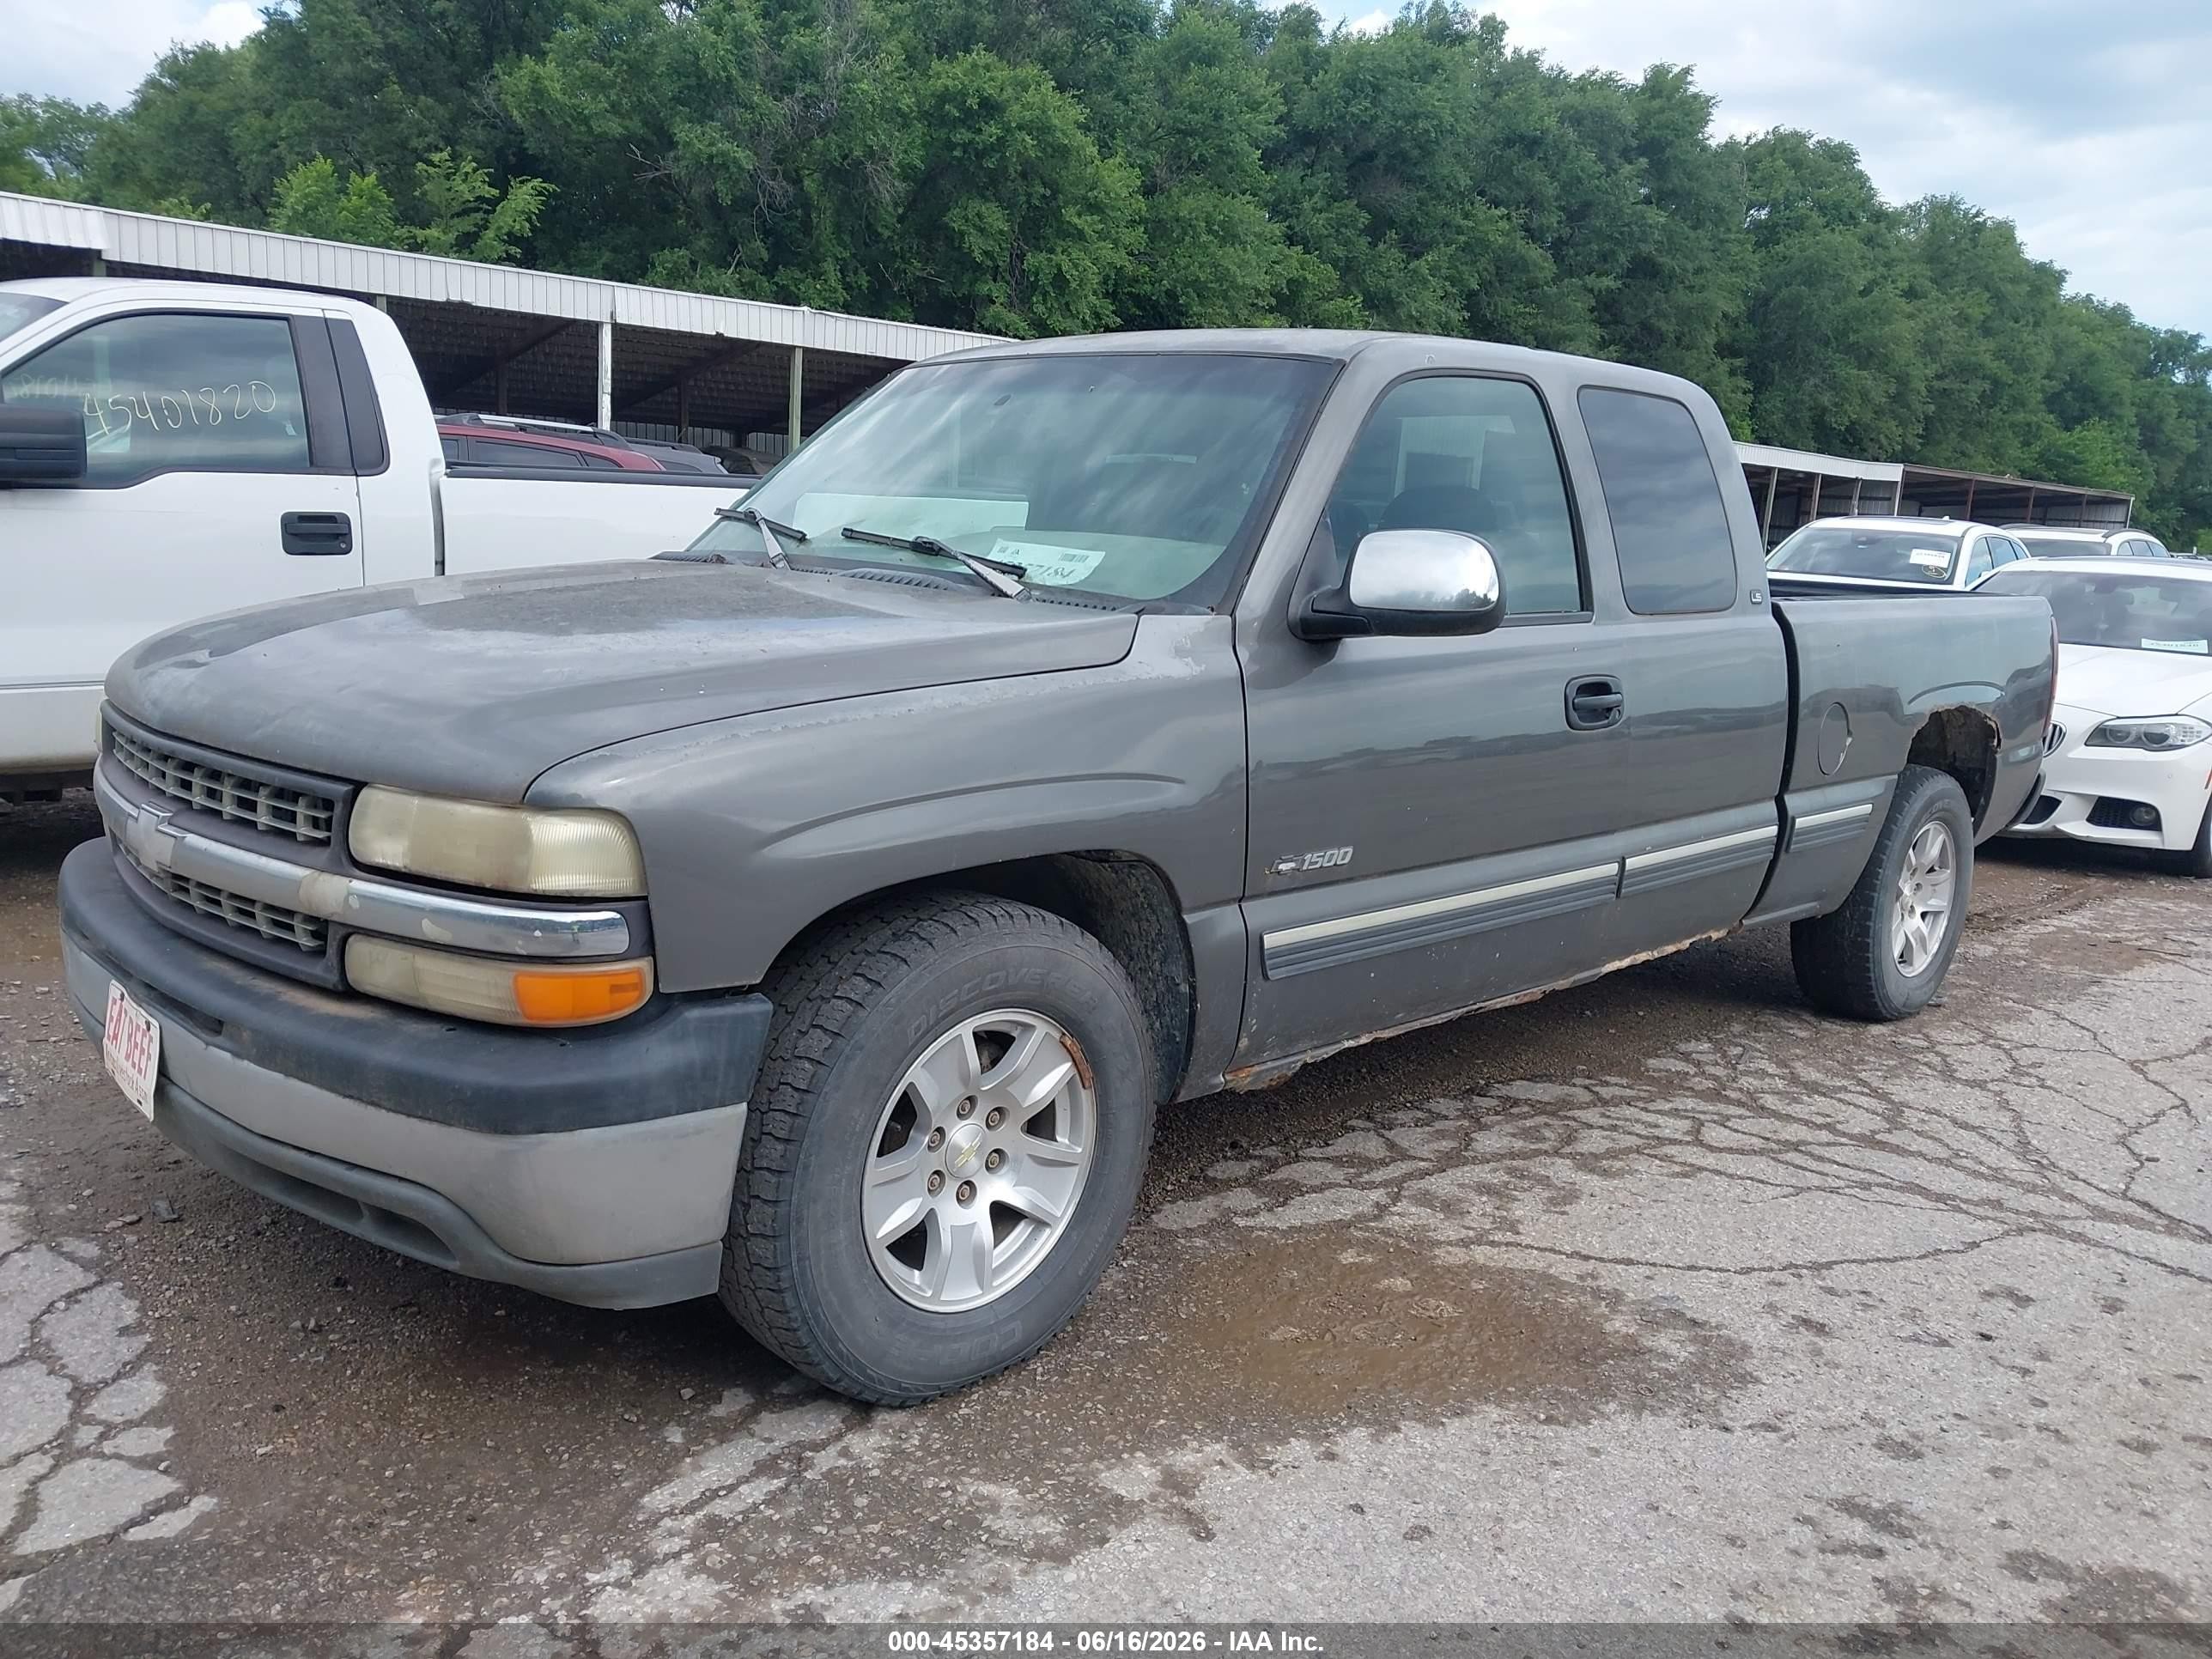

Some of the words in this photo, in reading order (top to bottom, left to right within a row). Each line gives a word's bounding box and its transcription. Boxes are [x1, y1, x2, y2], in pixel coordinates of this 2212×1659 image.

[83, 380, 276, 435] 45401820
[1751, 592, 1762, 603] LS
[1302, 846, 1354, 872] 1500
[106, 995, 128, 1054] EAT
[124, 1014, 154, 1081] BEEF
